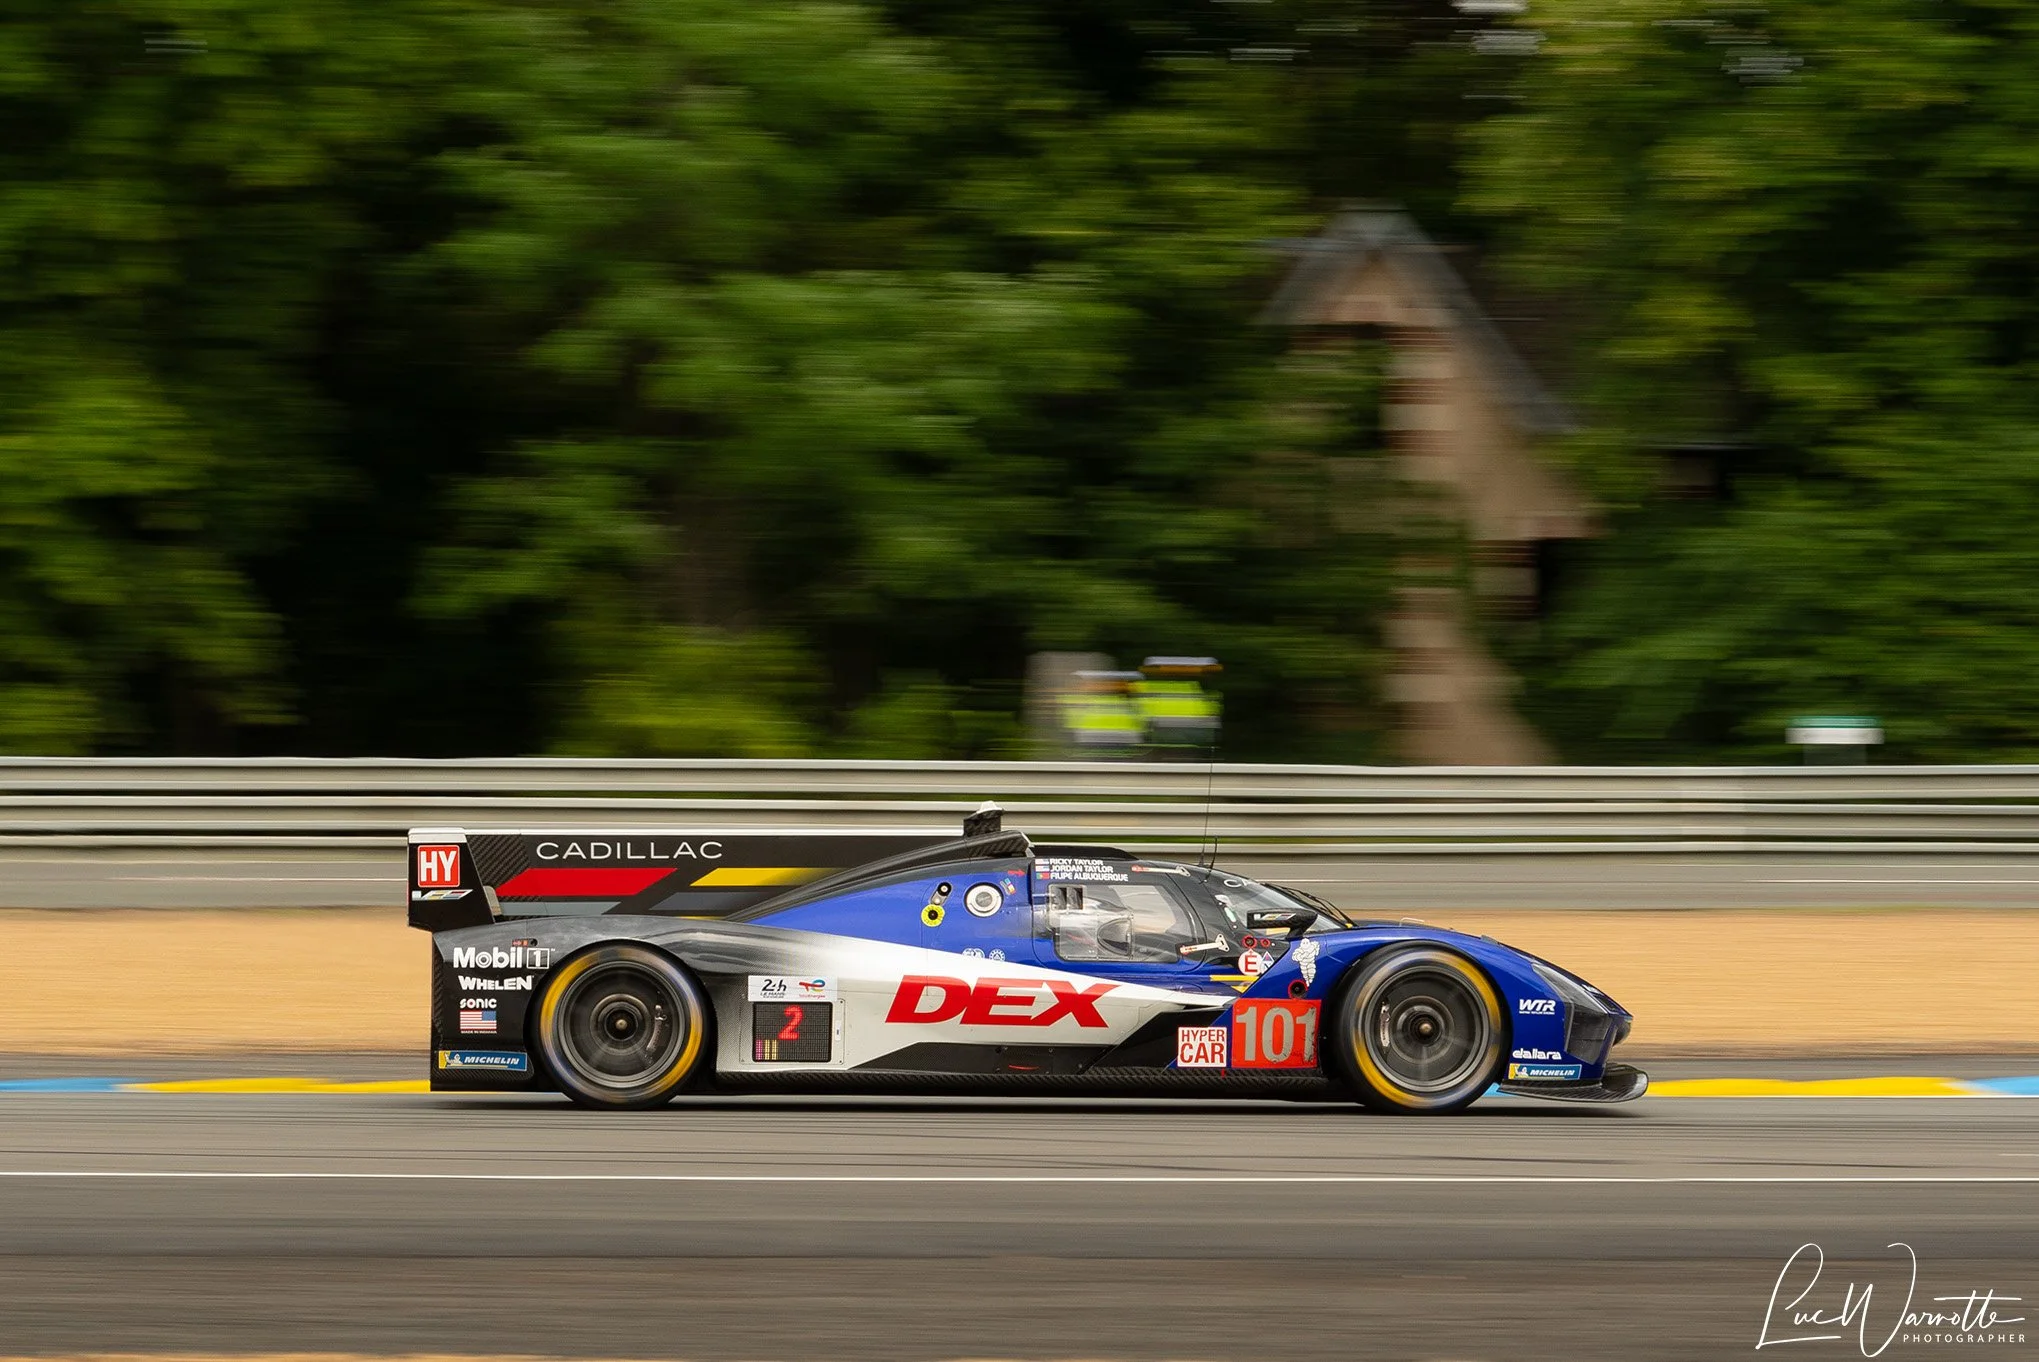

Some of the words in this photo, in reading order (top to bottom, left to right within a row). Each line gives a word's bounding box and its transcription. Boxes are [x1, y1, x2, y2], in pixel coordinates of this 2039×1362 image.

[536, 841, 723, 860] CADILLAC
[420, 850, 457, 882] HY
[1084, 865, 1114, 873] TAYLOR
[1050, 872, 1073, 880] FILIPE
[1074, 873, 1129, 881] ALBUQUERQUE
[453, 946, 523, 969] Mobil
[1244, 955, 1258, 973] E
[458, 975, 532, 990] WHELEN
[885, 974, 1121, 1029] DEX
[1519, 998, 1556, 1012] WTR
[778, 1004, 804, 1041] 2
[1181, 1029, 1225, 1042] HYPER
[1235, 1006, 1317, 1064] 101
[464, 1056, 520, 1064] MICHELIN
[1180, 1043, 1224, 1064] CAR
[1512, 1047, 1562, 1060] dallara
